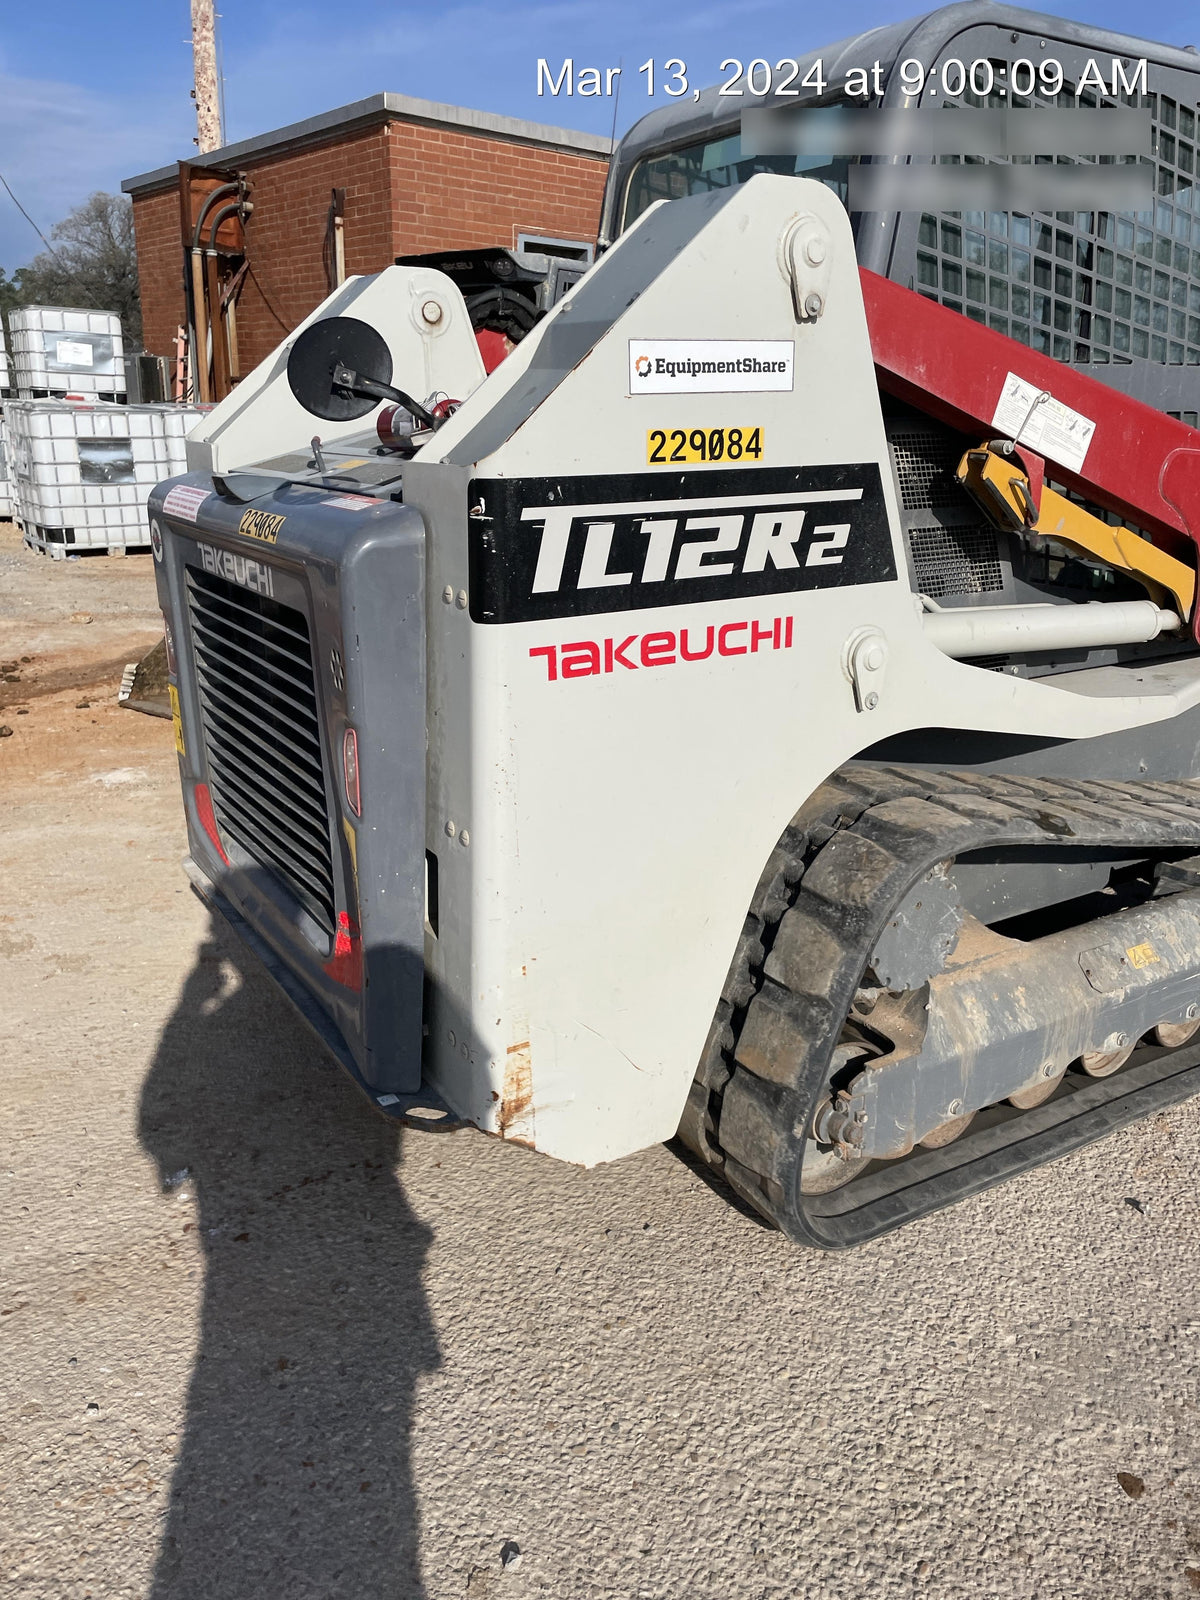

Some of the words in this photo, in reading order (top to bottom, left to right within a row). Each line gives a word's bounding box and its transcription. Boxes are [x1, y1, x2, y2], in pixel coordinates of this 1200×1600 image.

[655, 358, 786, 378] EquipmentShare
[649, 427, 762, 463] 229084
[240, 509, 286, 543] 229084
[519, 487, 865, 594] TL12R2
